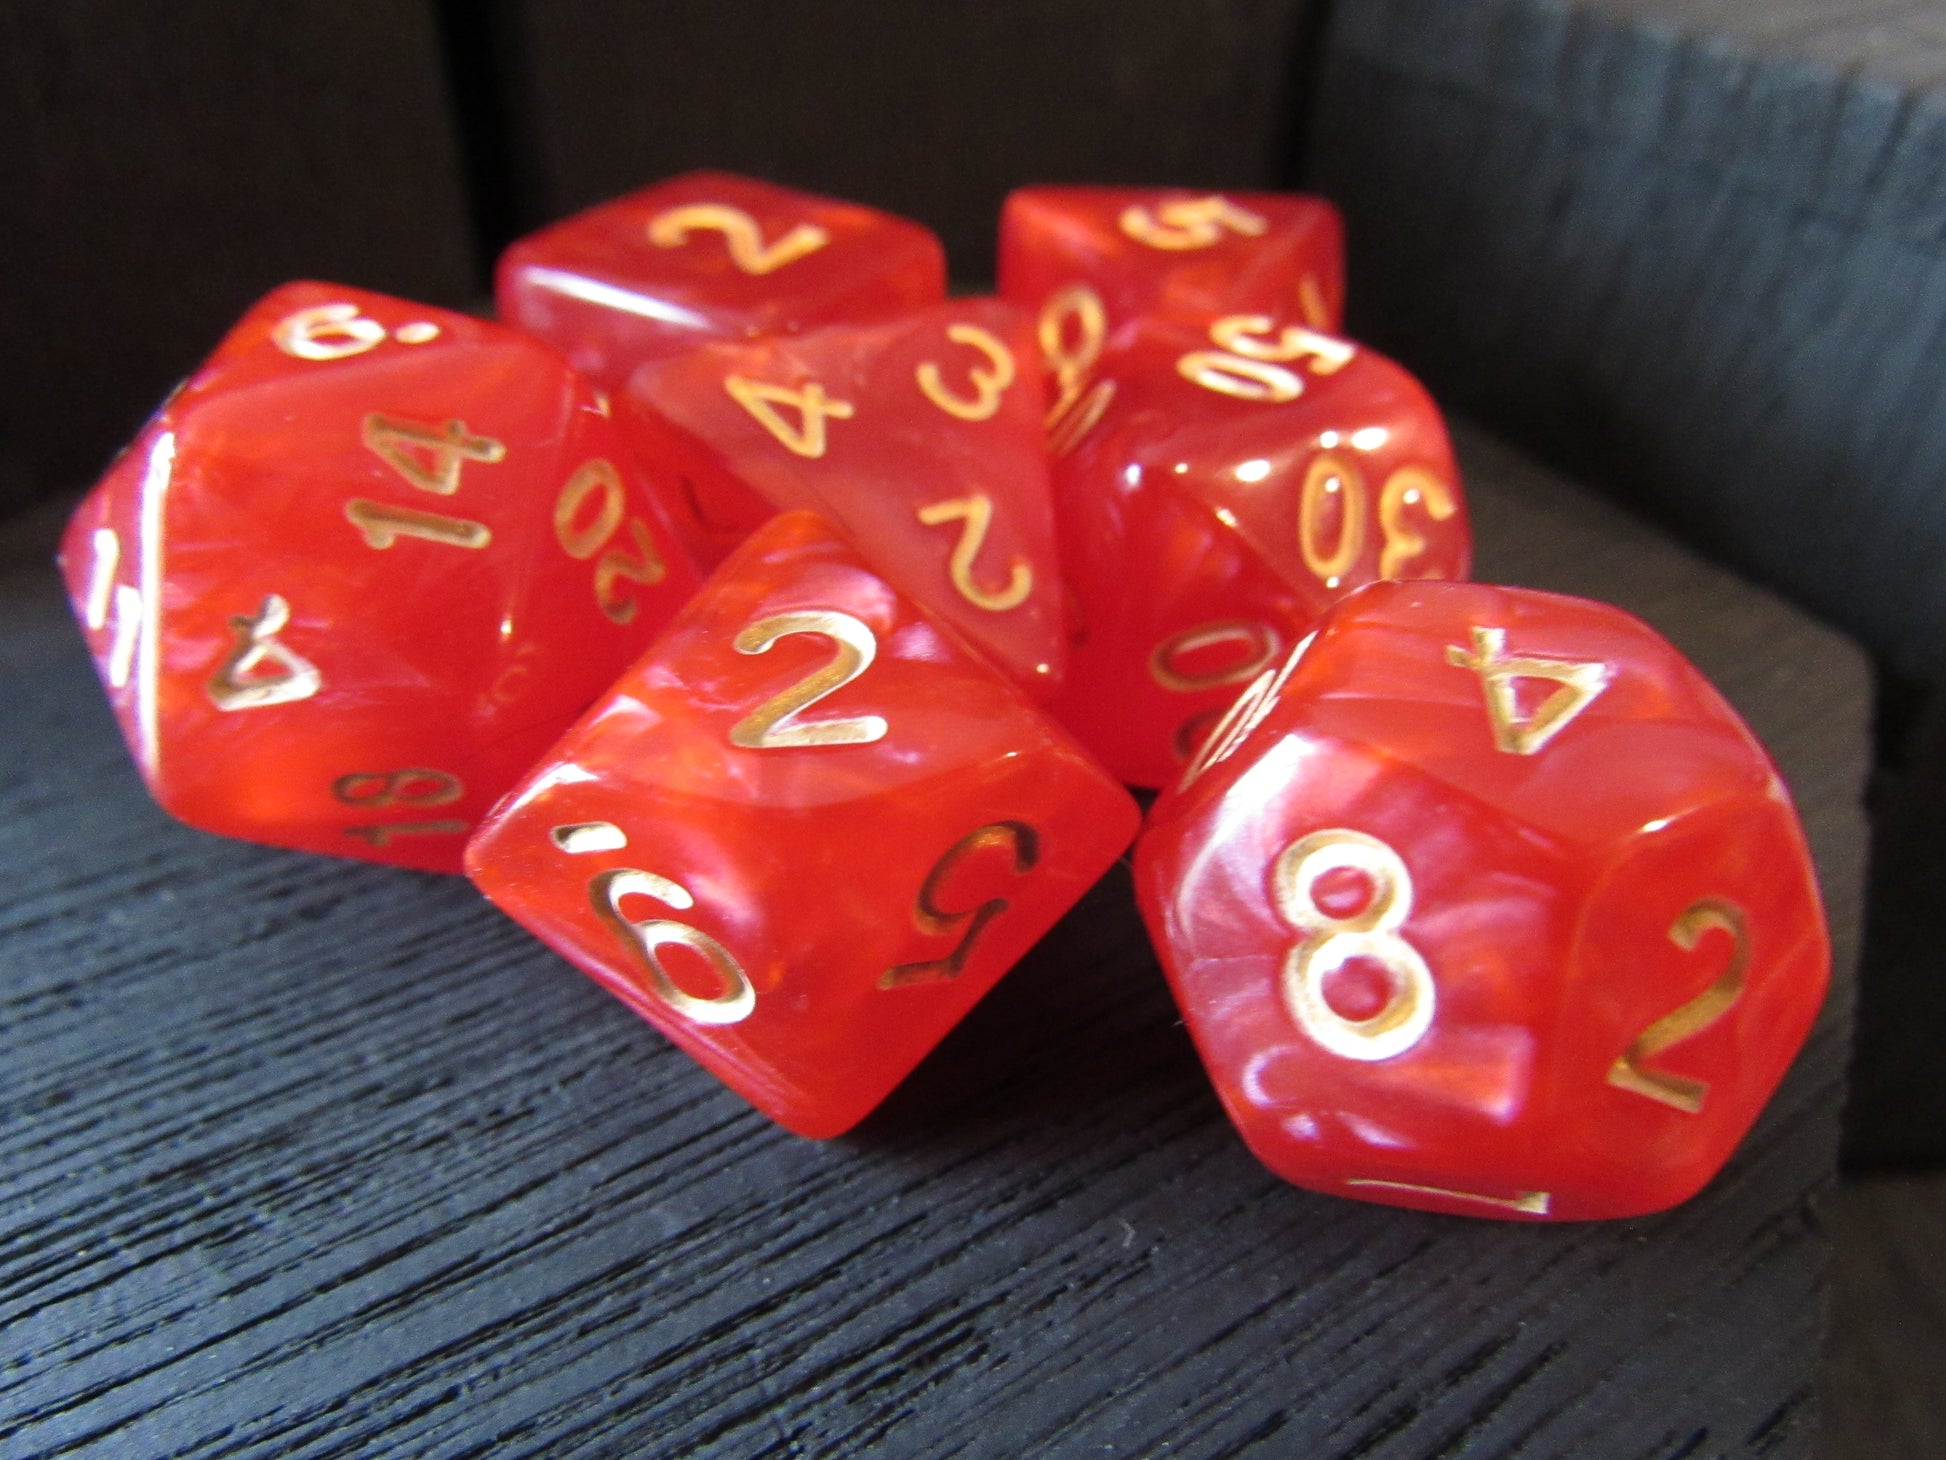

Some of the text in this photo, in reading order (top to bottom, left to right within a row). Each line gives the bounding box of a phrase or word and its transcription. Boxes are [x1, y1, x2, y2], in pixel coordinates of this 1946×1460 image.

[648, 203, 830, 276] 2
[725, 374, 855, 458] 4
[915, 323, 1015, 420] 3
[1158, 315, 1355, 401] 50
[344, 411, 506, 550] 14
[917, 493, 1033, 611] 2
[208, 594, 322, 712] 4
[730, 610, 888, 748] 2
[1446, 626, 1612, 755] 4
[332, 767, 472, 847] 18
[878, 819, 1041, 992] 5
[1276, 827, 1437, 1062] 8
[1607, 897, 1753, 1114] 2
